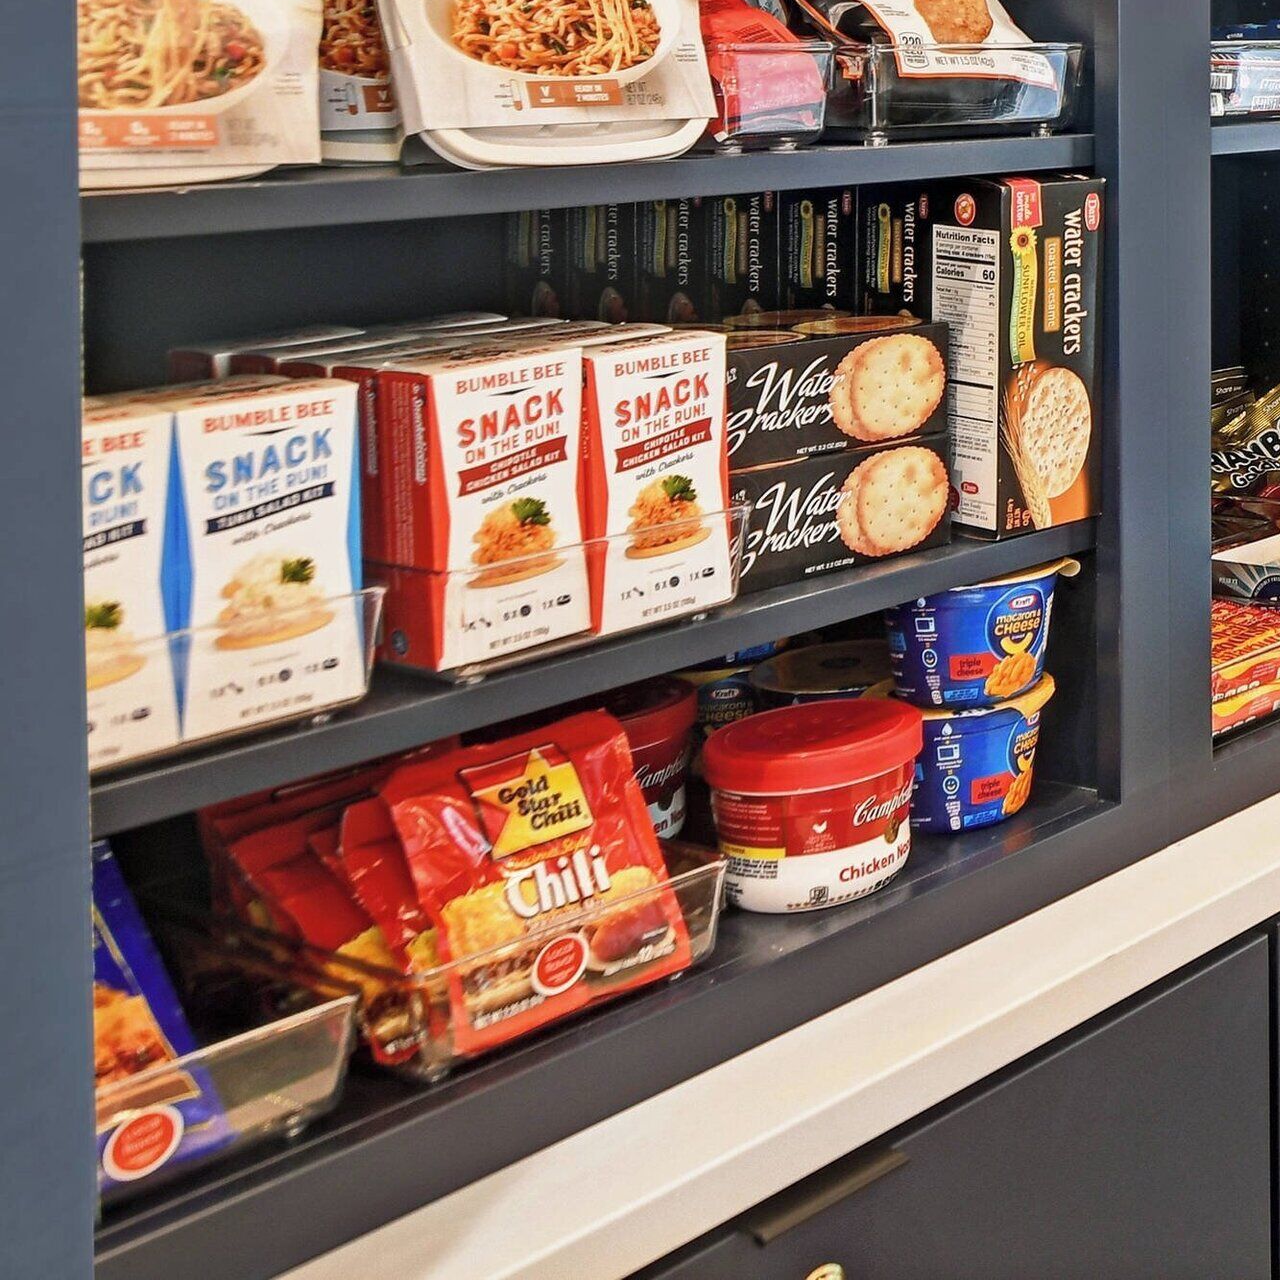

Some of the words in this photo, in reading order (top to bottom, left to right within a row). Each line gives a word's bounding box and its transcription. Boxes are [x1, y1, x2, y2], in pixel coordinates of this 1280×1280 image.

[826, 198, 838, 238] water
[903, 202, 915, 242] water
[1088, 197, 1097, 226] Dare
[936, 230, 970, 242] Nutrition
[972, 234, 995, 245] Facts
[1063, 207, 1082, 268] water
[749, 238, 763, 292] crackers
[826, 241, 841, 298] crackers
[903, 244, 918, 303] crackers
[936, 265, 965, 278] Calories
[982, 269, 995, 281] 60
[1019, 264, 1030, 328] SUNFLOWER
[1063, 272, 1088, 356] crackers
[455, 366, 530, 395] BUMBLE
[533, 362, 566, 380] BEE
[614, 352, 679, 378] BUMBLE
[682, 347, 712, 365] BEE
[614, 372, 710, 428] SNACK
[746, 354, 846, 416] Water
[203, 405, 289, 434] BUMBLE
[296, 399, 335, 421] BEE
[457, 387, 566, 450] SNACK
[621, 426, 641, 444] ON
[644, 413, 671, 436] THE
[674, 402, 707, 424] RUN!
[464, 446, 488, 465] ON
[490, 433, 520, 459] THE
[524, 420, 560, 444] RUN!
[543, 449, 560, 467] KIT
[622, 446, 662, 468] CHICKEN
[662, 435, 690, 457] SALAD
[691, 430, 707, 446] KIT
[643, 428, 687, 452] CHIPOTLE
[204, 426, 333, 494] SNACK
[242, 478, 282, 502] THE
[755, 471, 853, 537] Water
[1014, 597, 1031, 607] Kraft
[959, 658, 982, 670] triple
[498, 775, 549, 803] Gold
[518, 792, 562, 817] Star
[981, 780, 1000, 793] triple
[503, 844, 612, 919] Chili
[839, 851, 895, 883] Chicken
